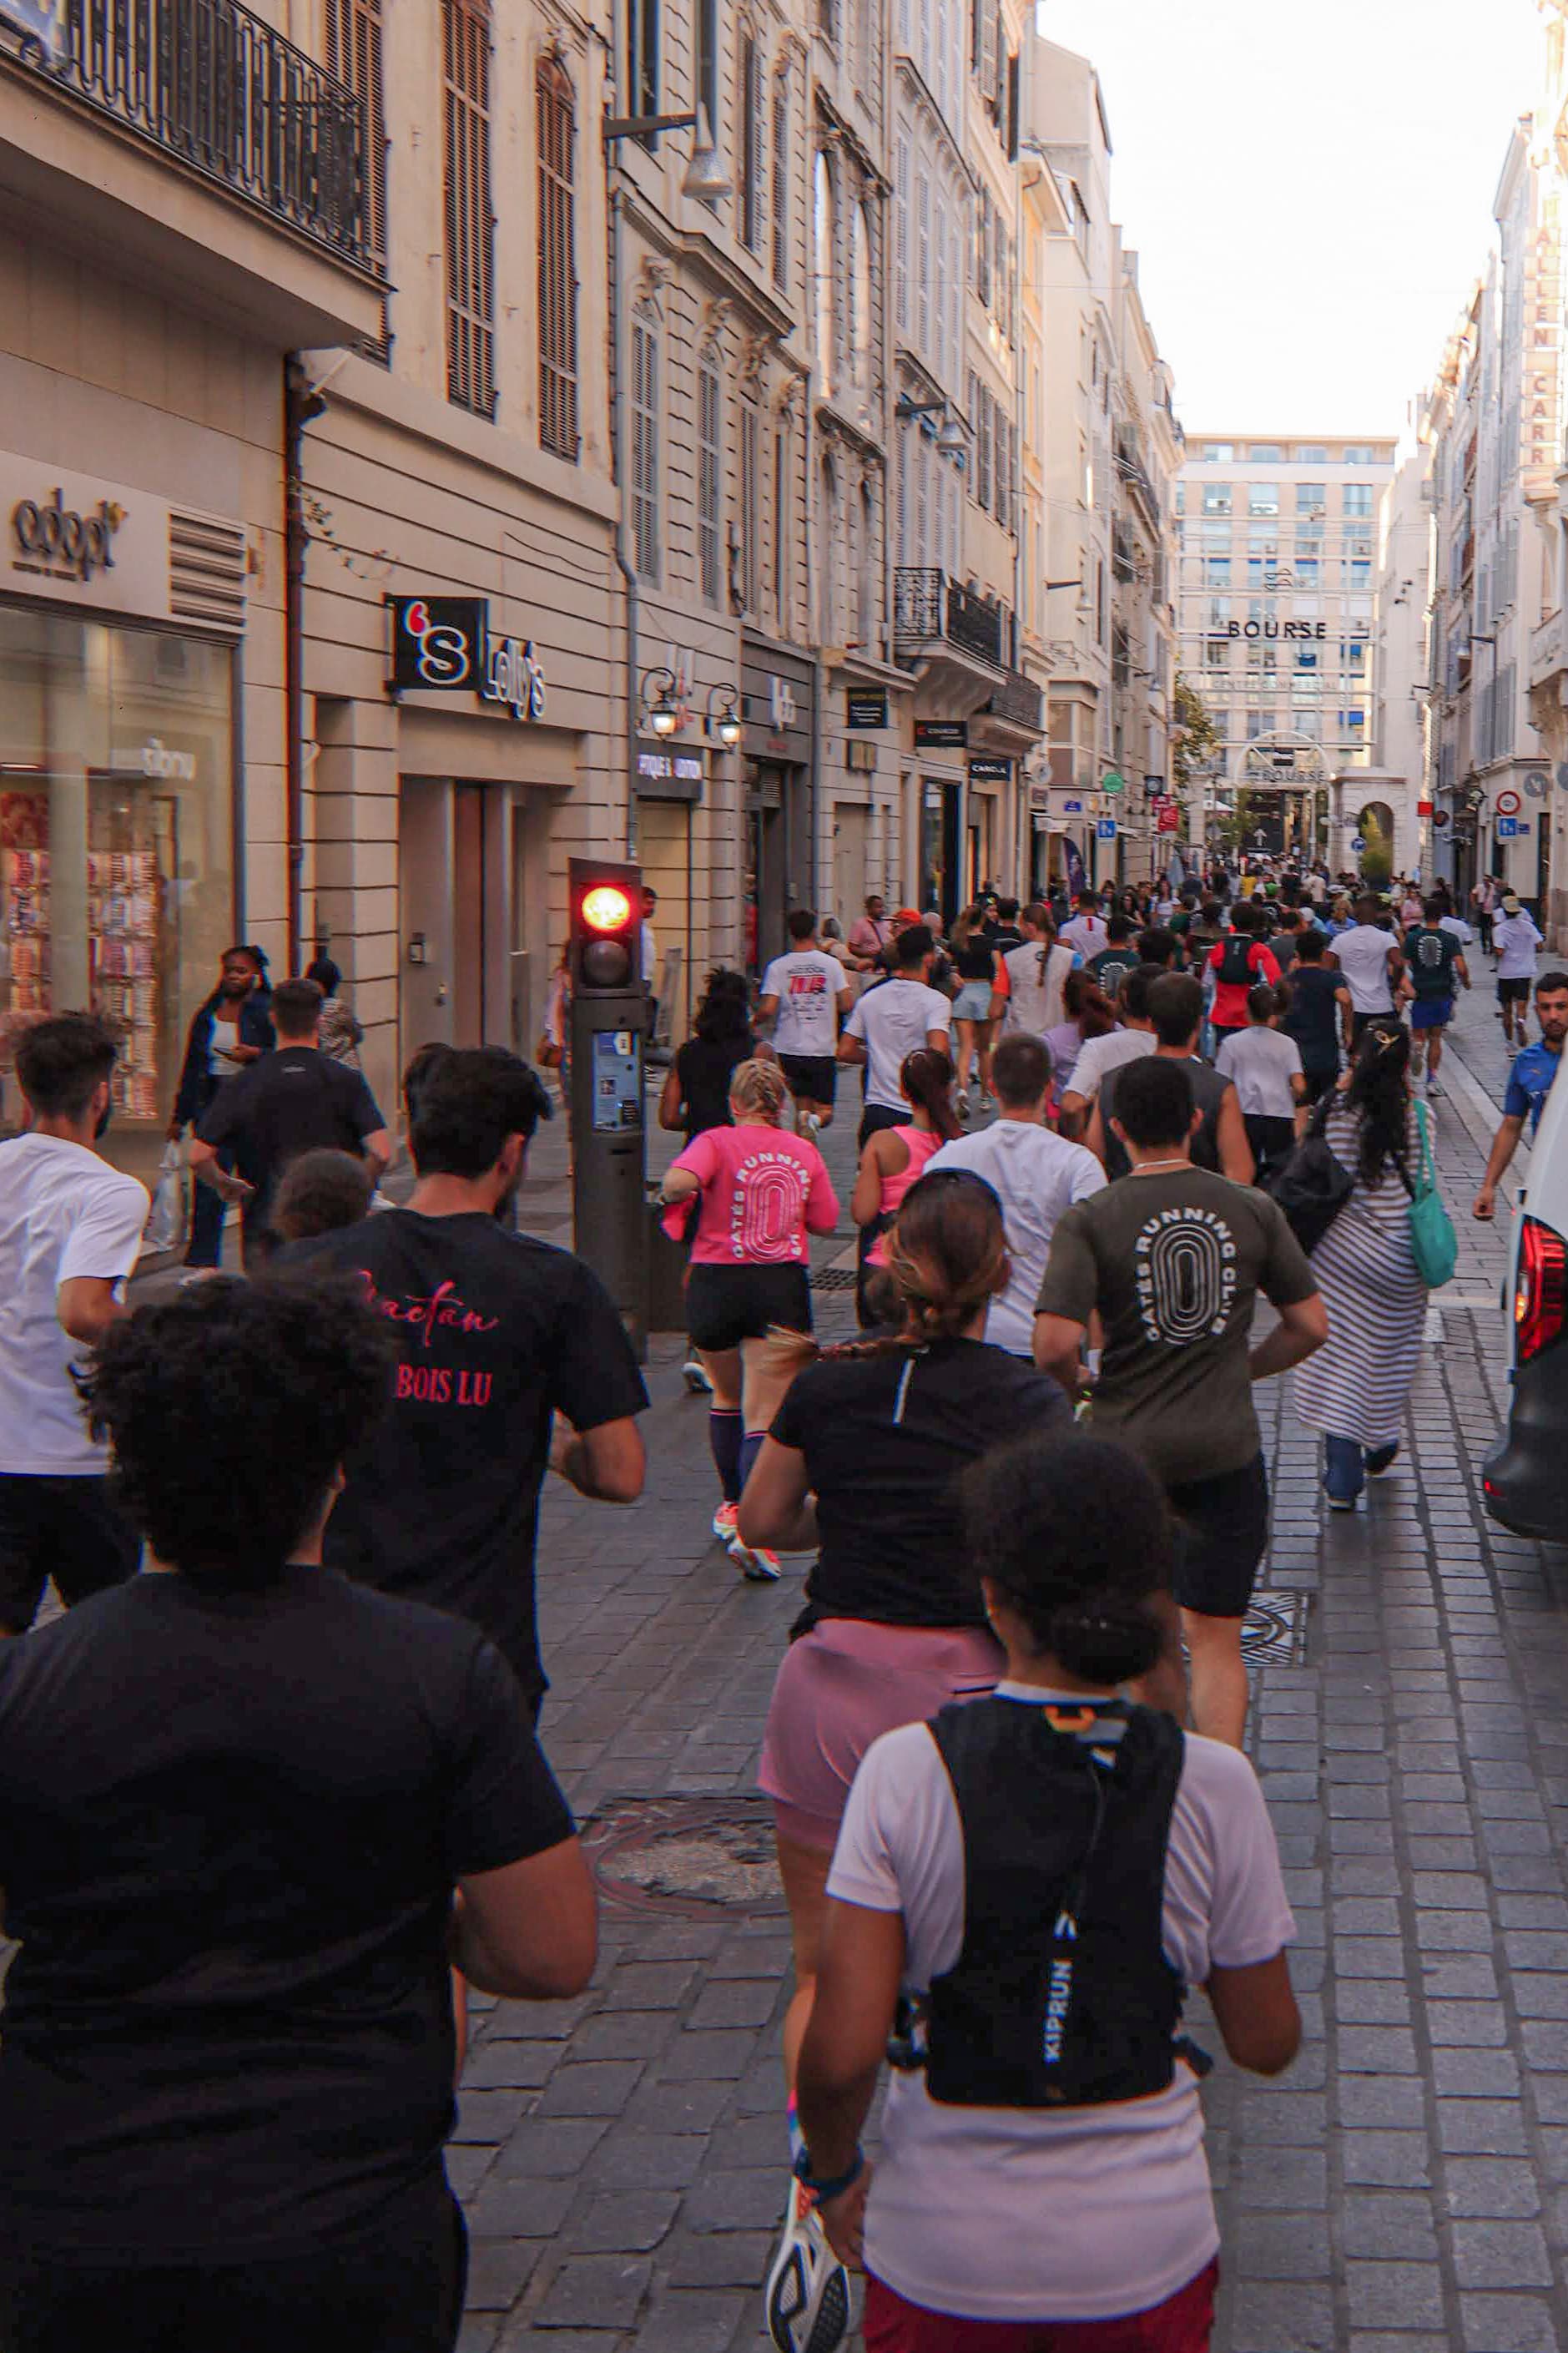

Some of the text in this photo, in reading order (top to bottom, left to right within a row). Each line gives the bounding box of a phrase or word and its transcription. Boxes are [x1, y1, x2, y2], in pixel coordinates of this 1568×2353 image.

[1530, 227, 1552, 464] ALLEN CARR
[1228, 620, 1327, 639] BOURSE
[1134, 1207, 1237, 1259] RUNNING
[396, 1362, 493, 1406] BOIS LU
[1042, 1958, 1074, 2065] KIPRUN
